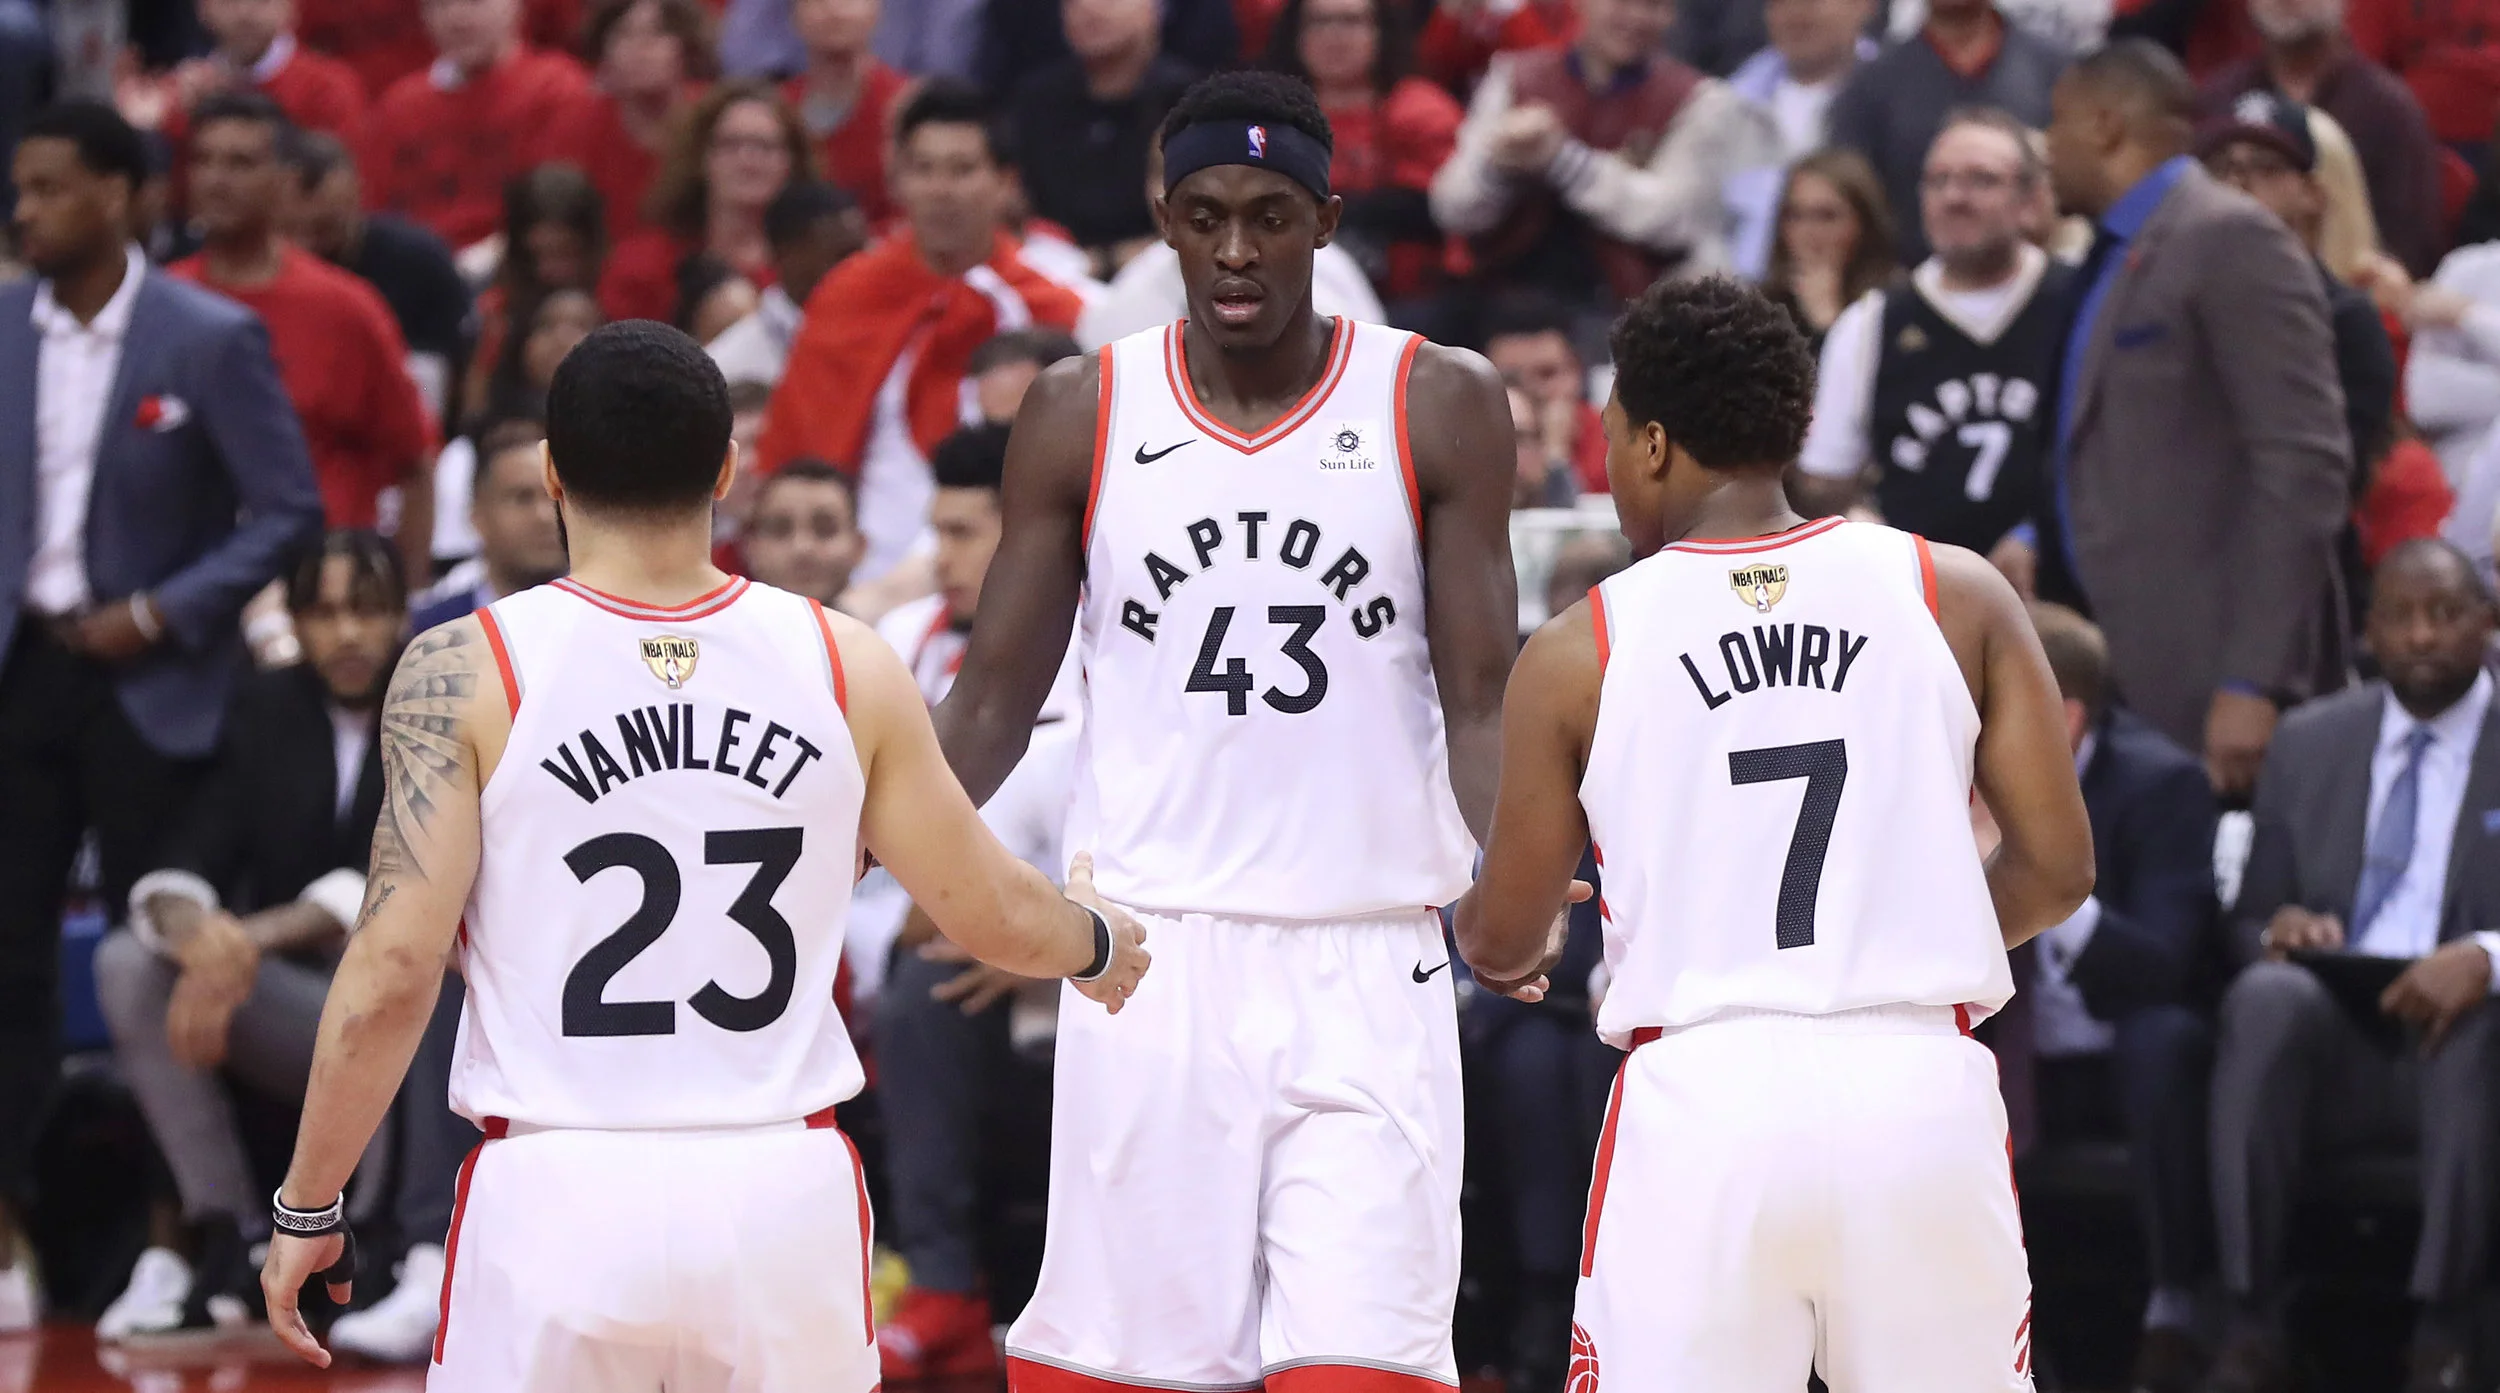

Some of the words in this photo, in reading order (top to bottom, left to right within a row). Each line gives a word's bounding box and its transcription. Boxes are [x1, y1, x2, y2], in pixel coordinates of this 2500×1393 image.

[1319, 459, 1346, 470] Sun
[1350, 458, 1376, 470] Life
[1956, 420, 2013, 502] 7
[1120, 510, 1398, 644] RAPTORS
[1732, 571, 1753, 587] NBA
[1753, 567, 1786, 585] FINALS
[643, 641, 663, 658] NBA
[663, 641, 696, 658] FINALS
[1184, 604, 1329, 716] 43
[1678, 623, 1869, 711] LOWRY
[540, 703, 823, 805] VANVLEET
[1727, 738, 1849, 950] 7
[561, 826, 805, 1038] 23
